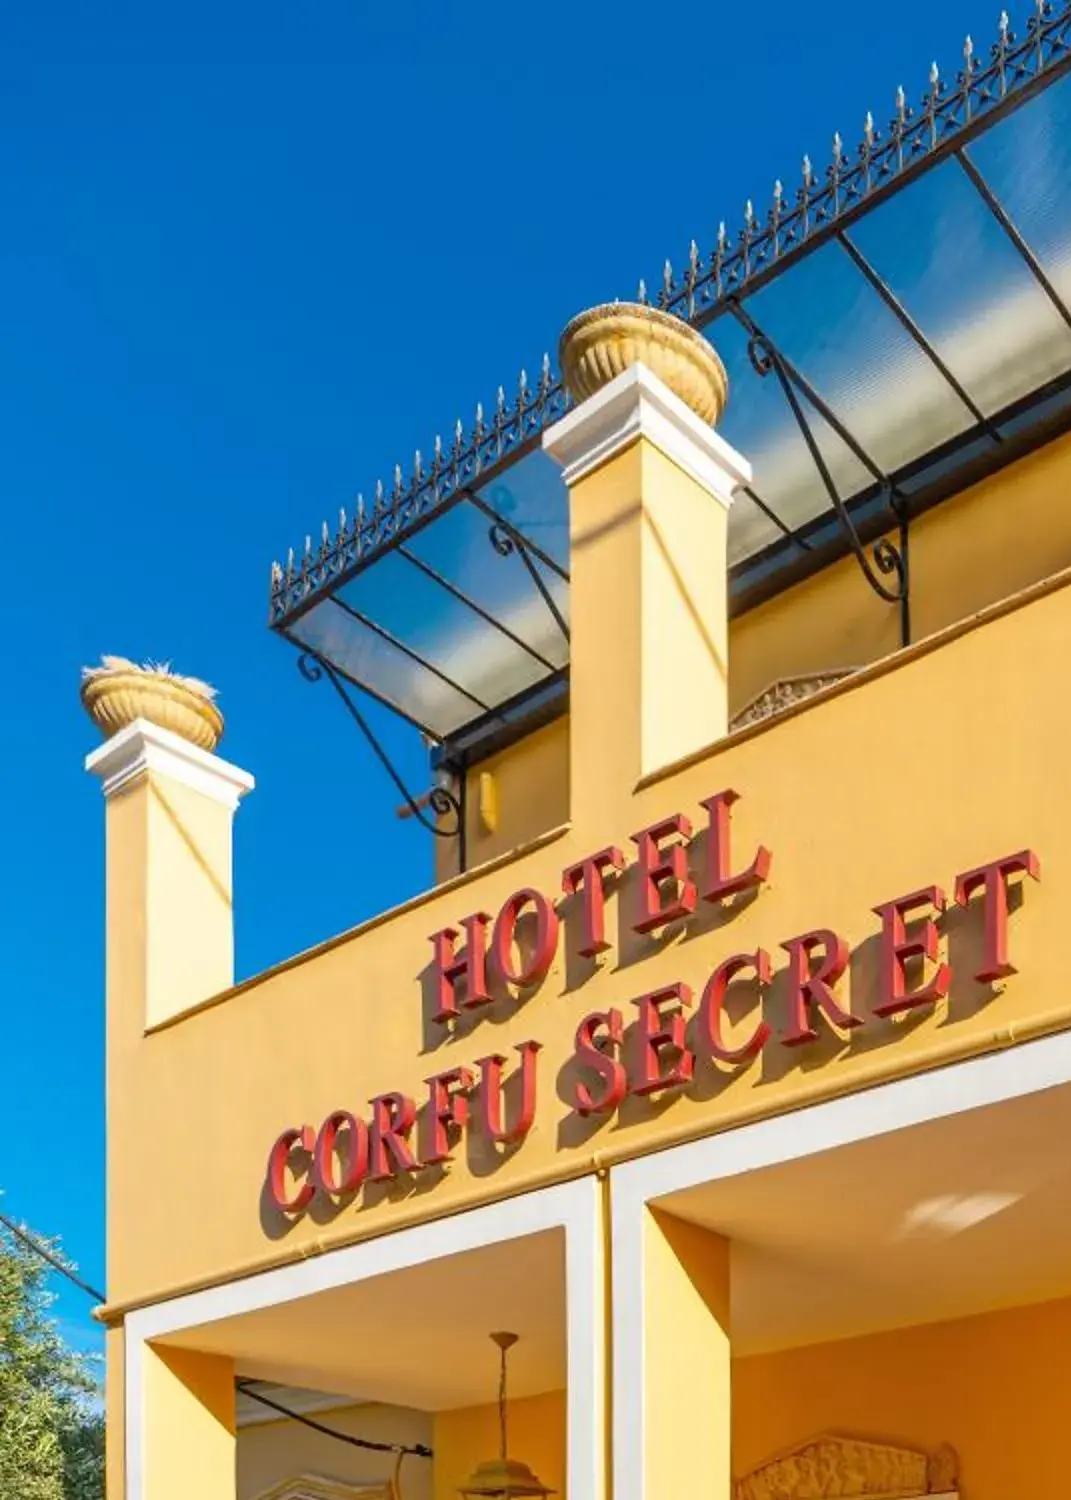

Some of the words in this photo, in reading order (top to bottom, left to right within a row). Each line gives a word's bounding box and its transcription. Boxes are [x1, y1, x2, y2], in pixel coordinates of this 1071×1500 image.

[267, 1038, 545, 1214] CORFU
[572, 848, 1041, 1117] SECRET
[428, 788, 772, 1025] HOTEL
